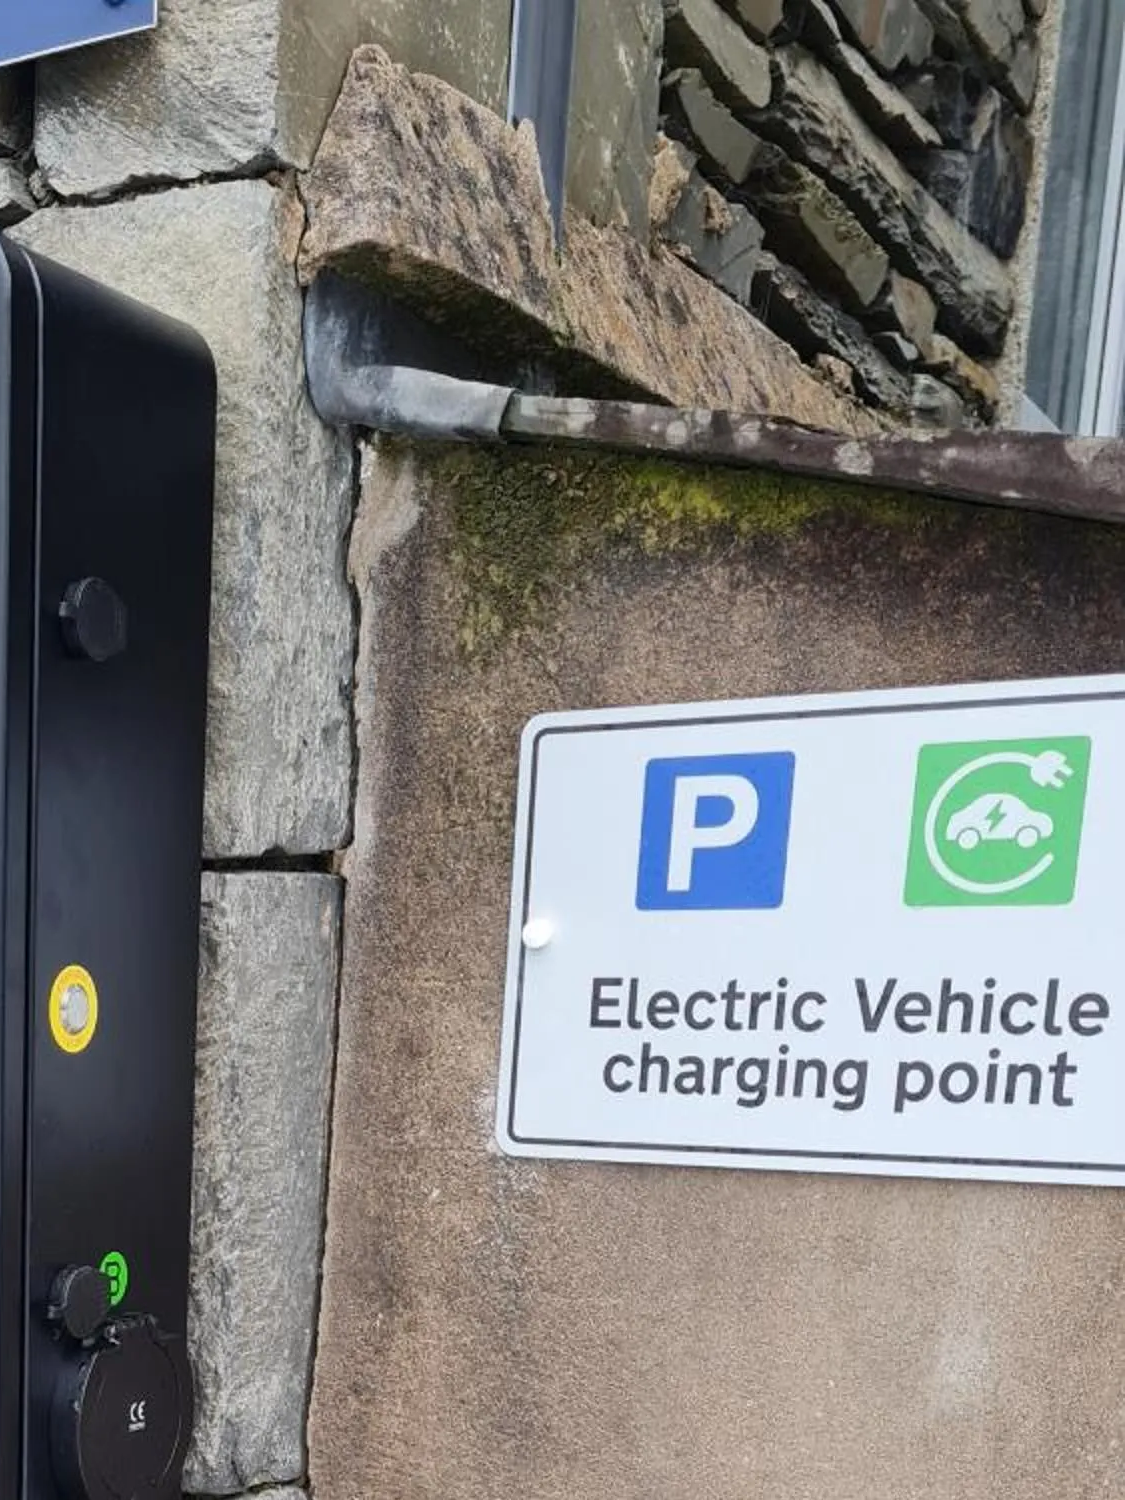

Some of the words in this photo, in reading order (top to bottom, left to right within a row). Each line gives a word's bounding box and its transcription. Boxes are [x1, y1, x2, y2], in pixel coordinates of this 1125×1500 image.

[666, 774, 759, 892] P
[589, 976, 827, 1032] Electric
[854, 977, 1111, 1037] Vehicle
[602, 1043, 869, 1112] charging
[893, 1048, 1078, 1113] point
